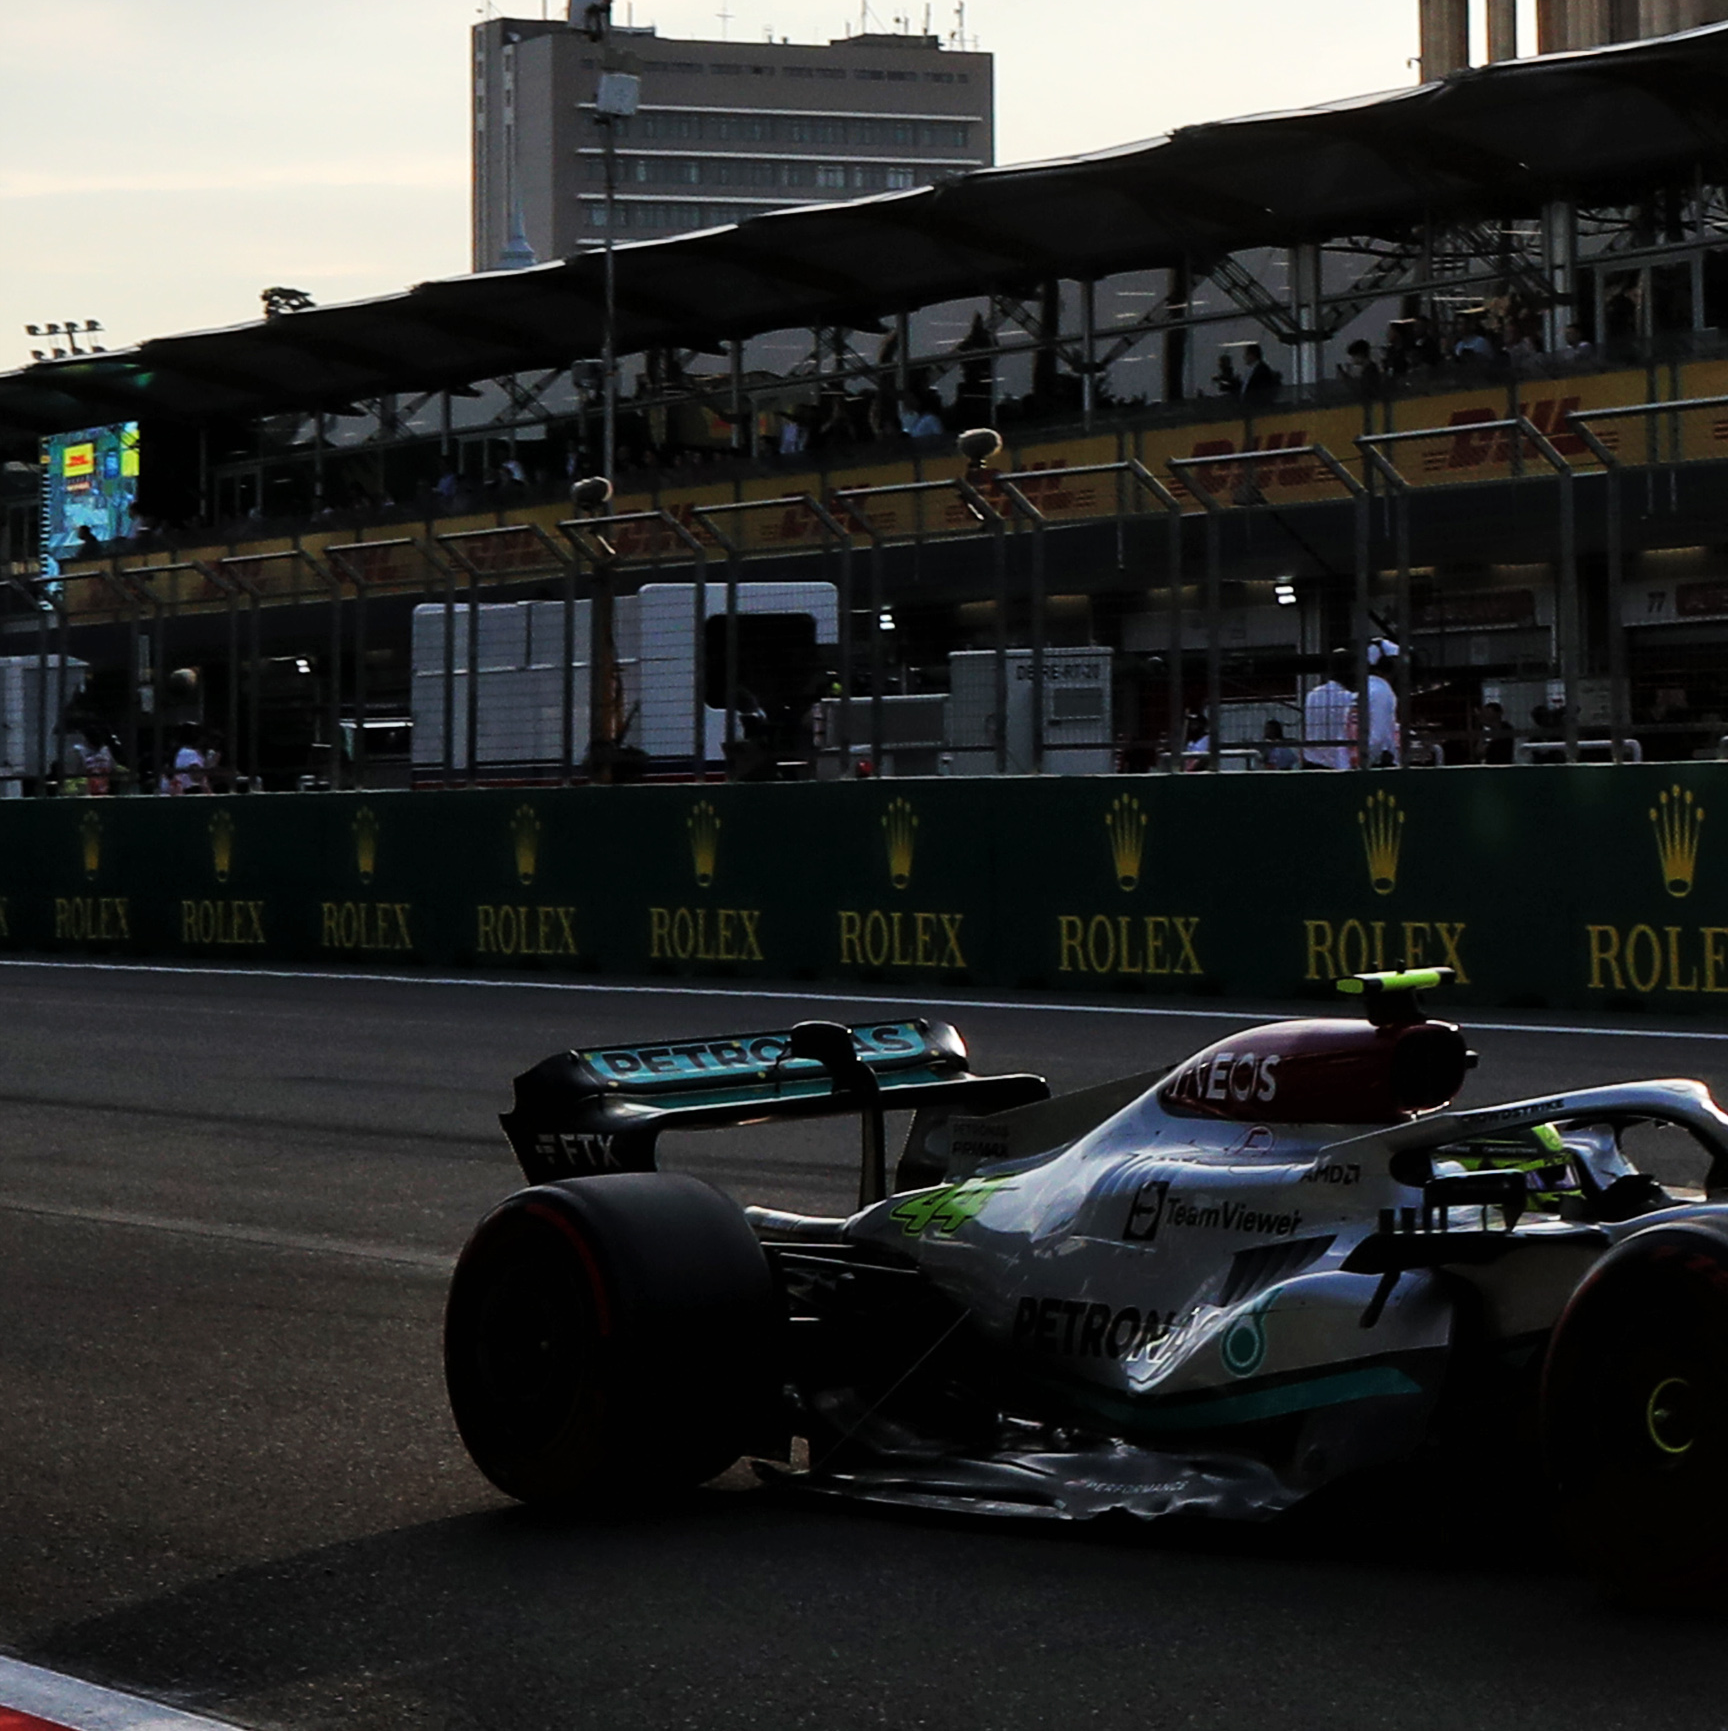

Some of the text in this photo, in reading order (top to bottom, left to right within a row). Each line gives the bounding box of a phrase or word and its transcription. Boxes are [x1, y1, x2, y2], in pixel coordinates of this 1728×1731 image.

[1448, 396, 1589, 468] DHL
[1192, 431, 1314, 494] DHL
[181, 899, 266, 944] ROLEX
[320, 901, 413, 950] ROLEX
[477, 905, 578, 955] ROLEX
[648, 907, 764, 961] ROLEX
[837, 910, 966, 968] ROLEX
[1058, 914, 1202, 974] ROLEX
[1303, 919, 1470, 985] ROLEX
[1172, 1052, 1281, 1104] INEOS
[562, 1132, 623, 1168] FTX
[1300, 1163, 1344, 1184] AMD
[1166, 1204, 1303, 1236] TeamViewer
